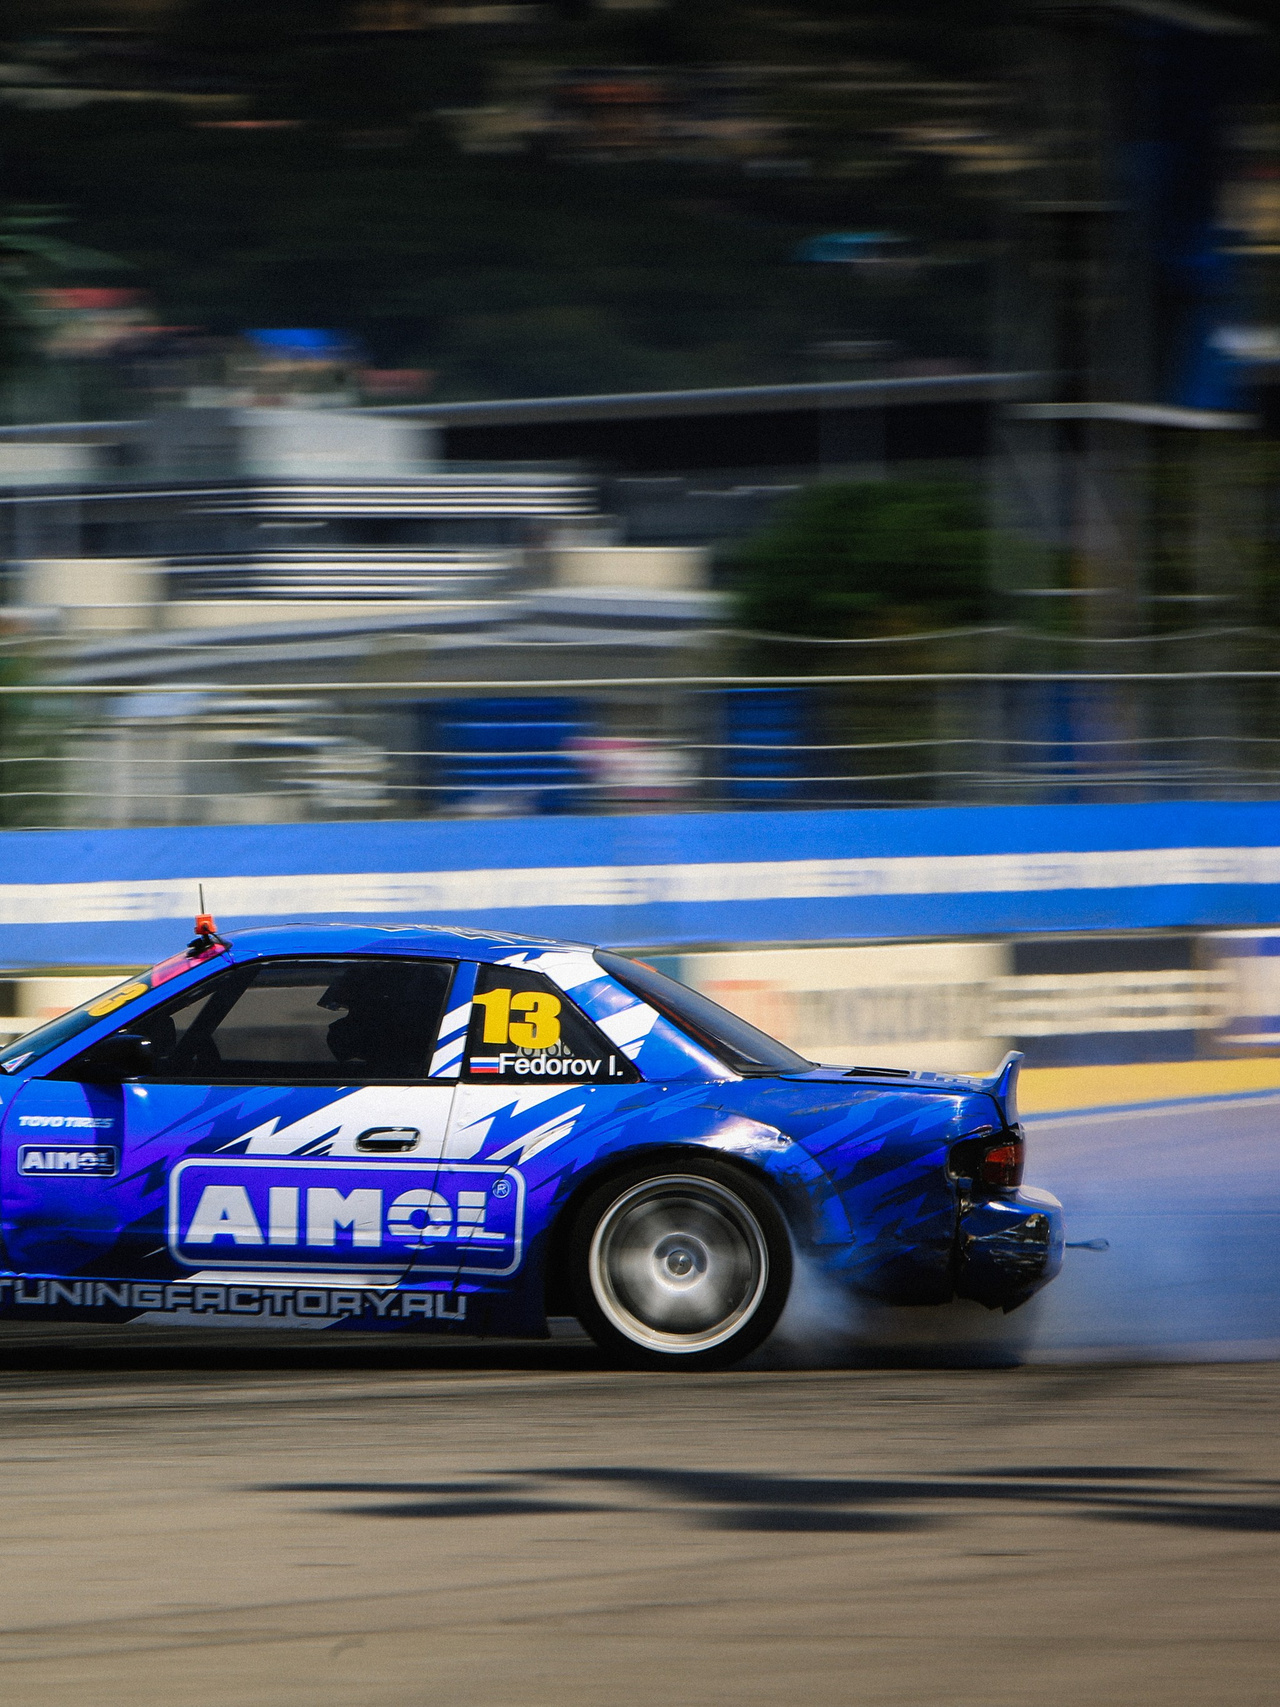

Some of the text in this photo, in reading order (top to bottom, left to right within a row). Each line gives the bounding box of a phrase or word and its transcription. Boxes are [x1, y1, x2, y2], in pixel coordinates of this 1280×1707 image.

[473, 988, 562, 1049] 13
[499, 1053, 624, 1076] Fedorov I.
[19, 1115, 115, 1128] TOYO TIRES
[22, 1151, 115, 1171] AIMOL
[184, 1184, 507, 1252] AIMOL
